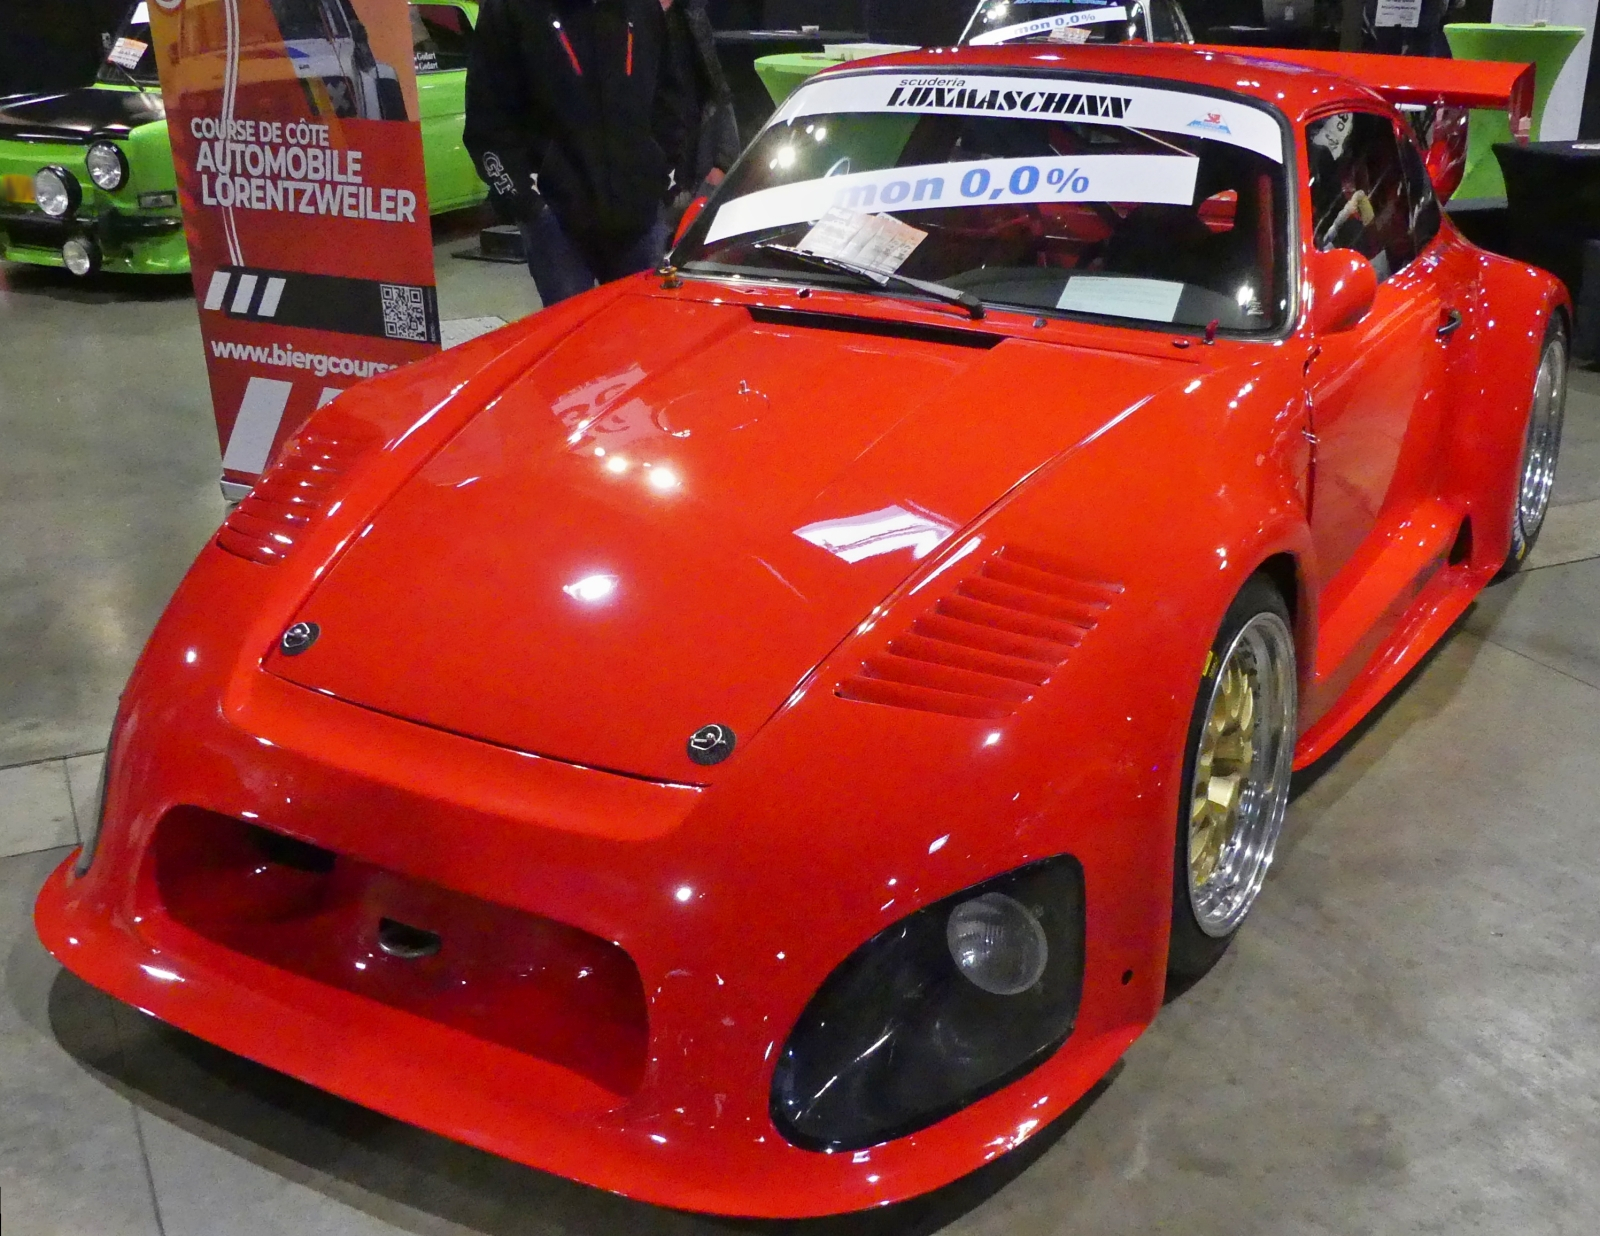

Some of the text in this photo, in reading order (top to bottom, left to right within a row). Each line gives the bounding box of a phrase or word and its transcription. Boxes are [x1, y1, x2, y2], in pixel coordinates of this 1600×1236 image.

[899, 77, 966, 87] scuderia
[190, 117, 330, 147] COURSE DE CÔTE
[196, 141, 363, 184] AUTOMOBILE
[201, 174, 417, 223] LORENTZWEILER
[210, 340, 402, 378] www.biergcours
